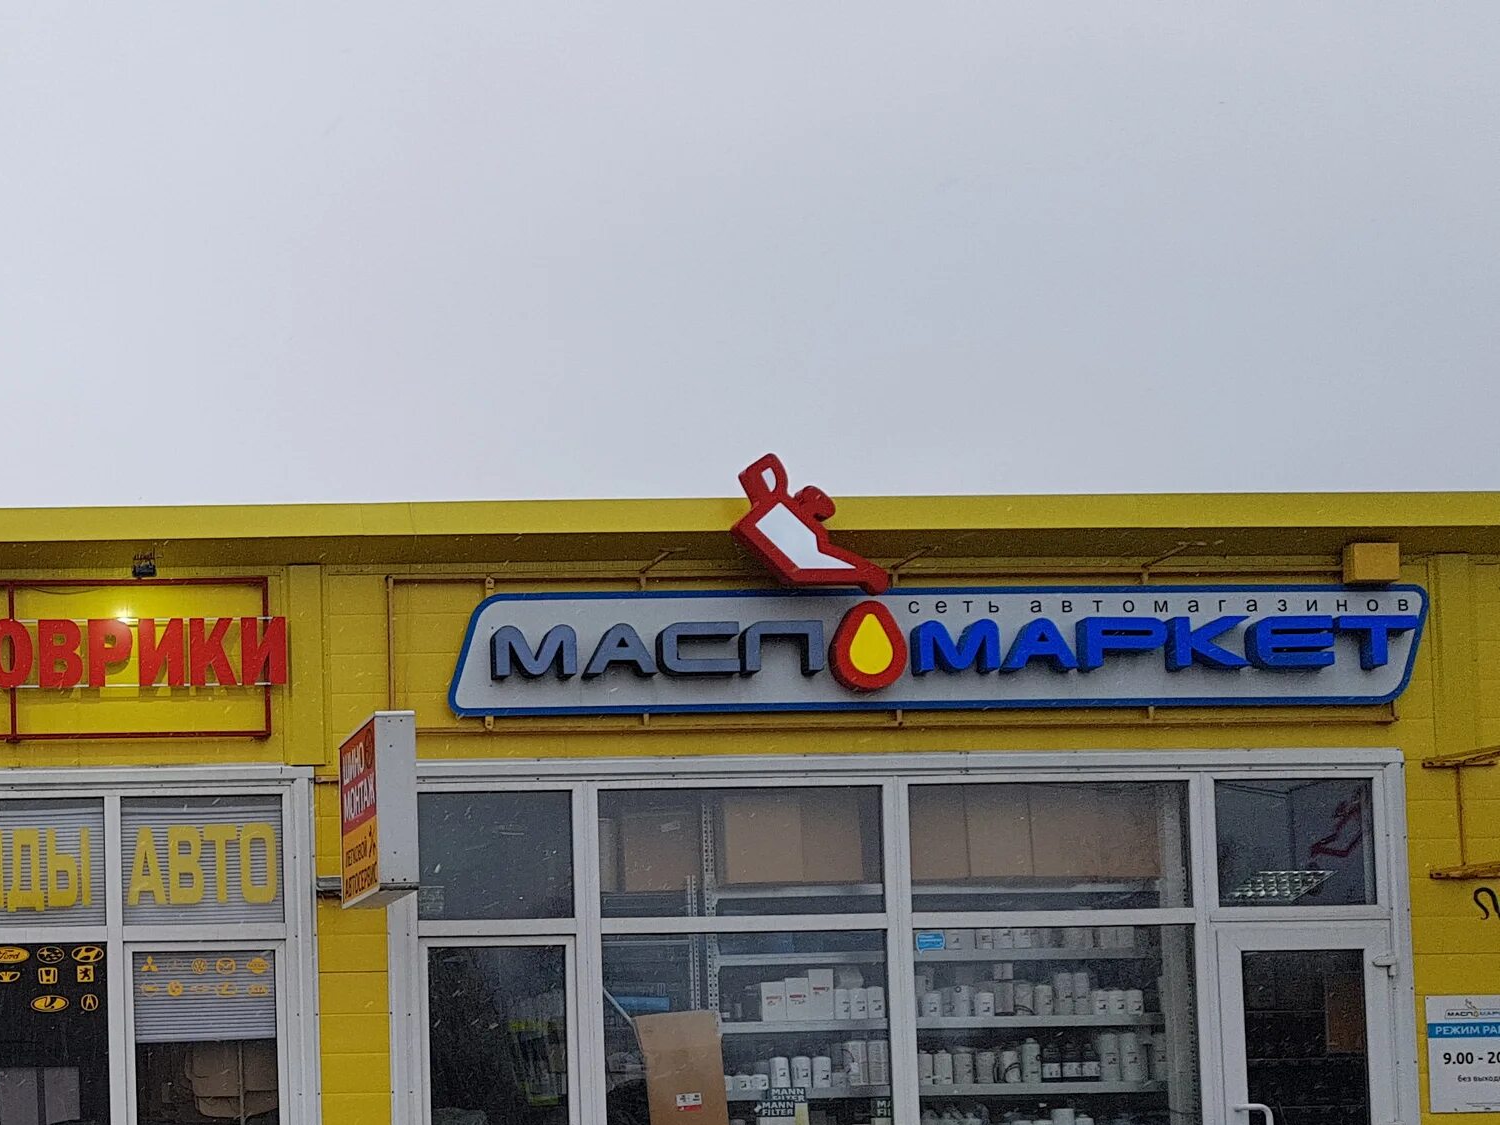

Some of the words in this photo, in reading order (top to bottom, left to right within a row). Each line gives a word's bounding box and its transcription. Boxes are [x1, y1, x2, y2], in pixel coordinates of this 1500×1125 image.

[908, 600, 1000, 613] сеть
[1030, 598, 1409, 613] автомагазинов
[342, 742, 364, 785] ШИНО
[343, 772, 376, 823] МОНТАЖ
[127, 823, 277, 906] АВТО
[1435, 1025, 1481, 1035] РЕЖИМ
[1443, 1052, 1474, 1065] 9.00
[1457, 1074, 1471, 1082] без
[762, 1101, 794, 1109] MANN
[762, 1108, 794, 1116] FILTER
